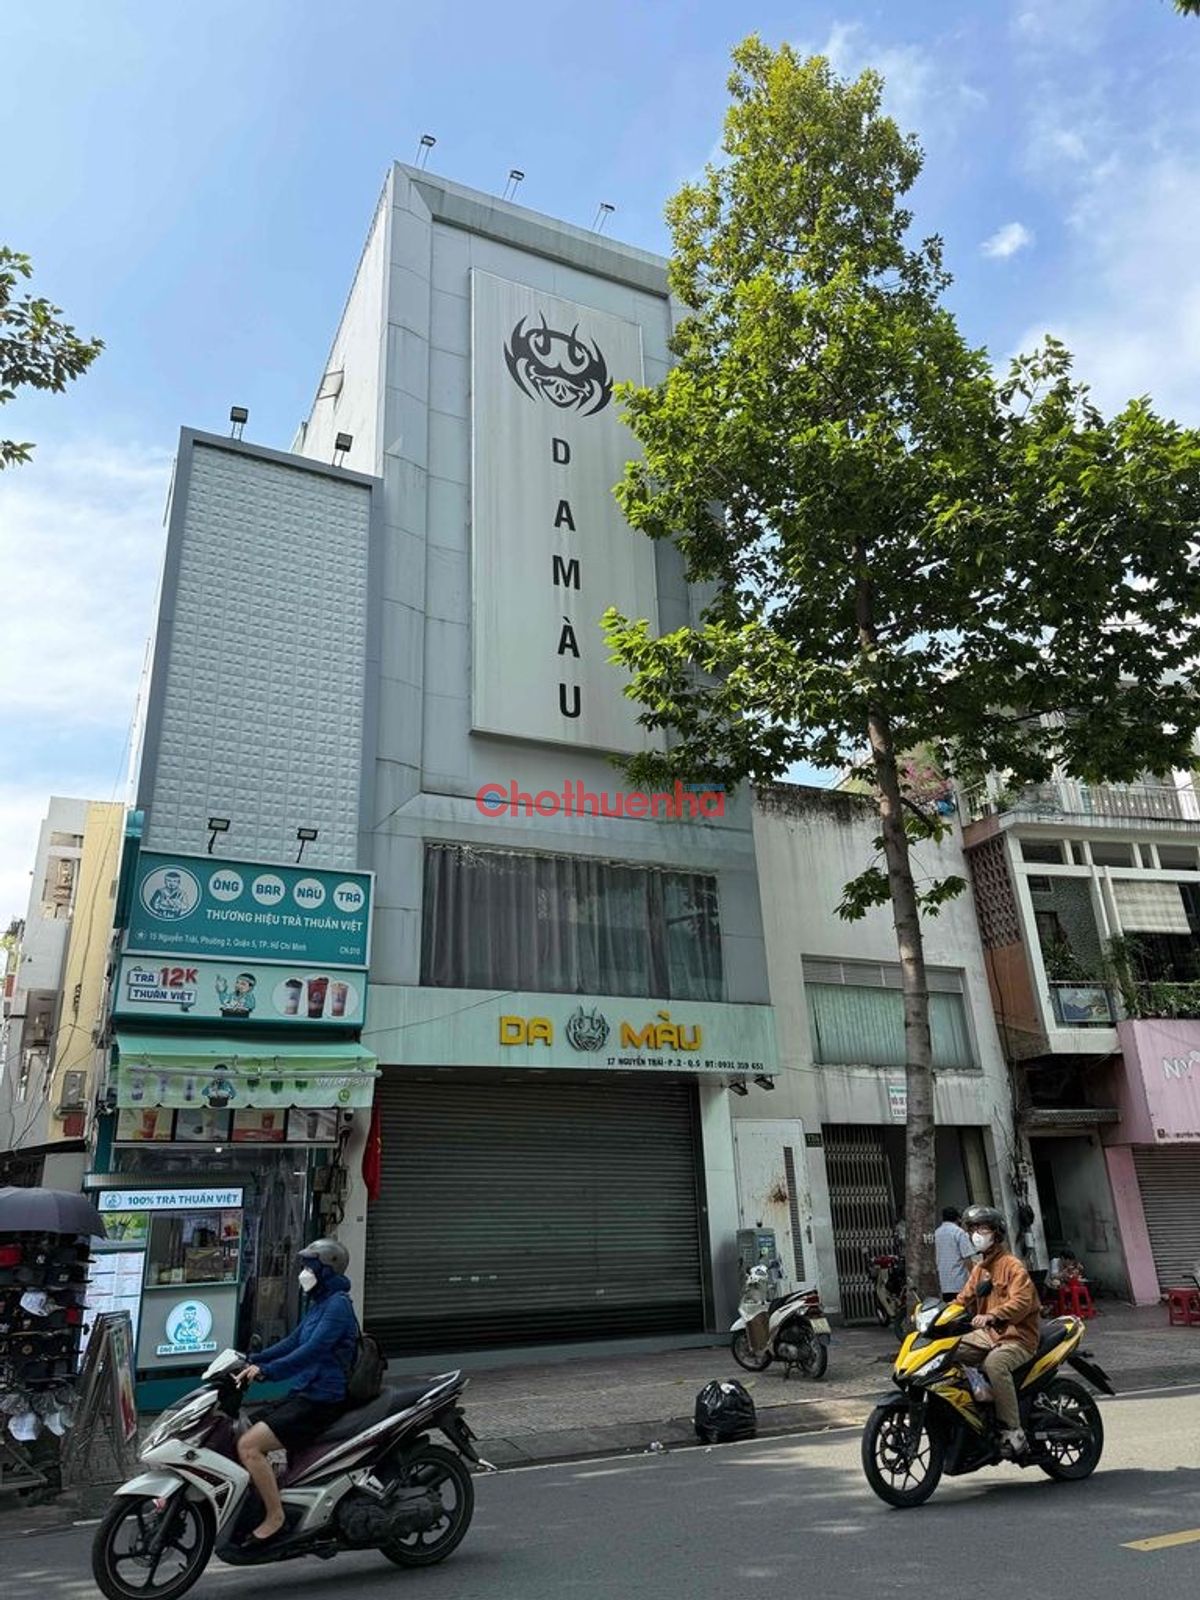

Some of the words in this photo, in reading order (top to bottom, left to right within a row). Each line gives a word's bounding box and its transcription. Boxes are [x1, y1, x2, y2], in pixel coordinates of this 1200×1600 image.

[255, 883, 282, 897] BAR
[206, 909, 253, 922] THƯƠNG
[254, 914, 280, 926] HIỆU
[282, 914, 302, 926] TRÀ
[340, 920, 364, 933] VIỆT
[160, 967, 198, 987] 12K
[499, 1015, 553, 1047] DA
[620, 1010, 703, 1051] MÀU
[128, 1195, 154, 1206] 100%
[156, 1194, 177, 1205] TRÀ
